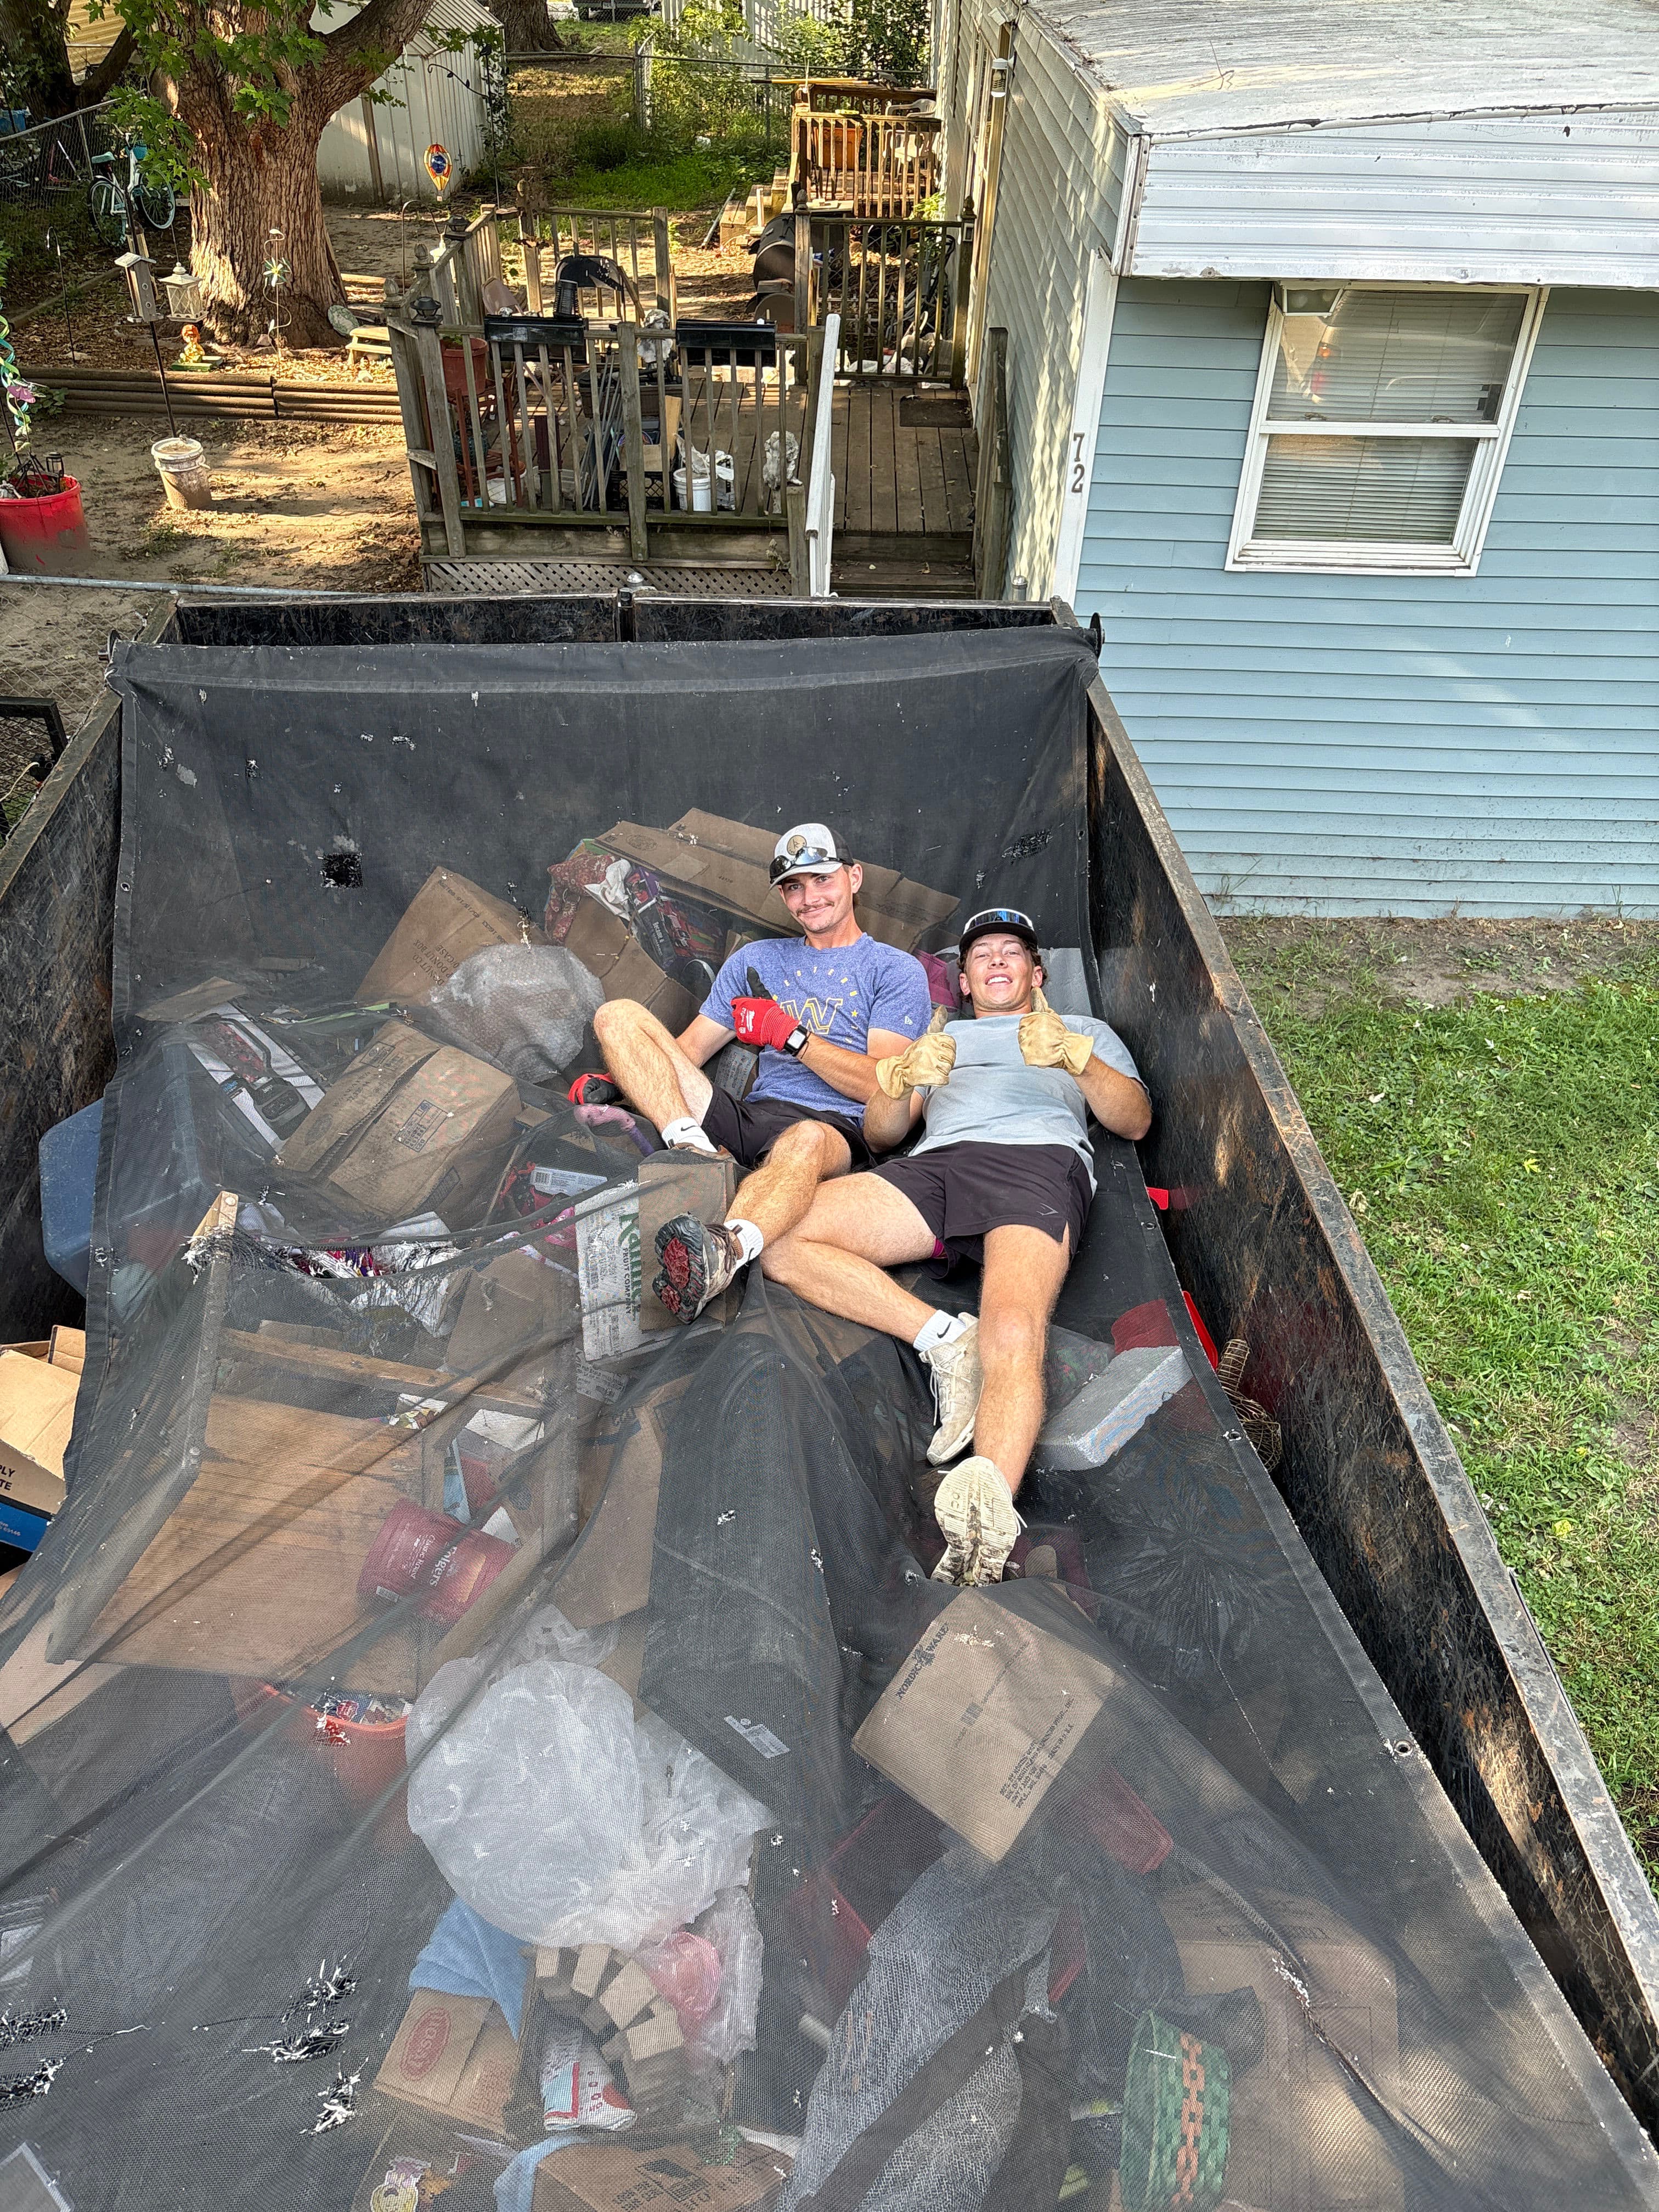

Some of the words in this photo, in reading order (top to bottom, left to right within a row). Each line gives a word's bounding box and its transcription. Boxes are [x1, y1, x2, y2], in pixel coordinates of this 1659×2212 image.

[1071, 433, 1085, 493] 72
[413, 938, 427, 953] BOX
[424, 949, 449, 974] DONUT
[780, 997, 843, 1035] W
[429, 1543, 458, 1587] Folgers
[894, 1662, 923, 1701] NORDIC
[924, 1623, 950, 1655] WARE
